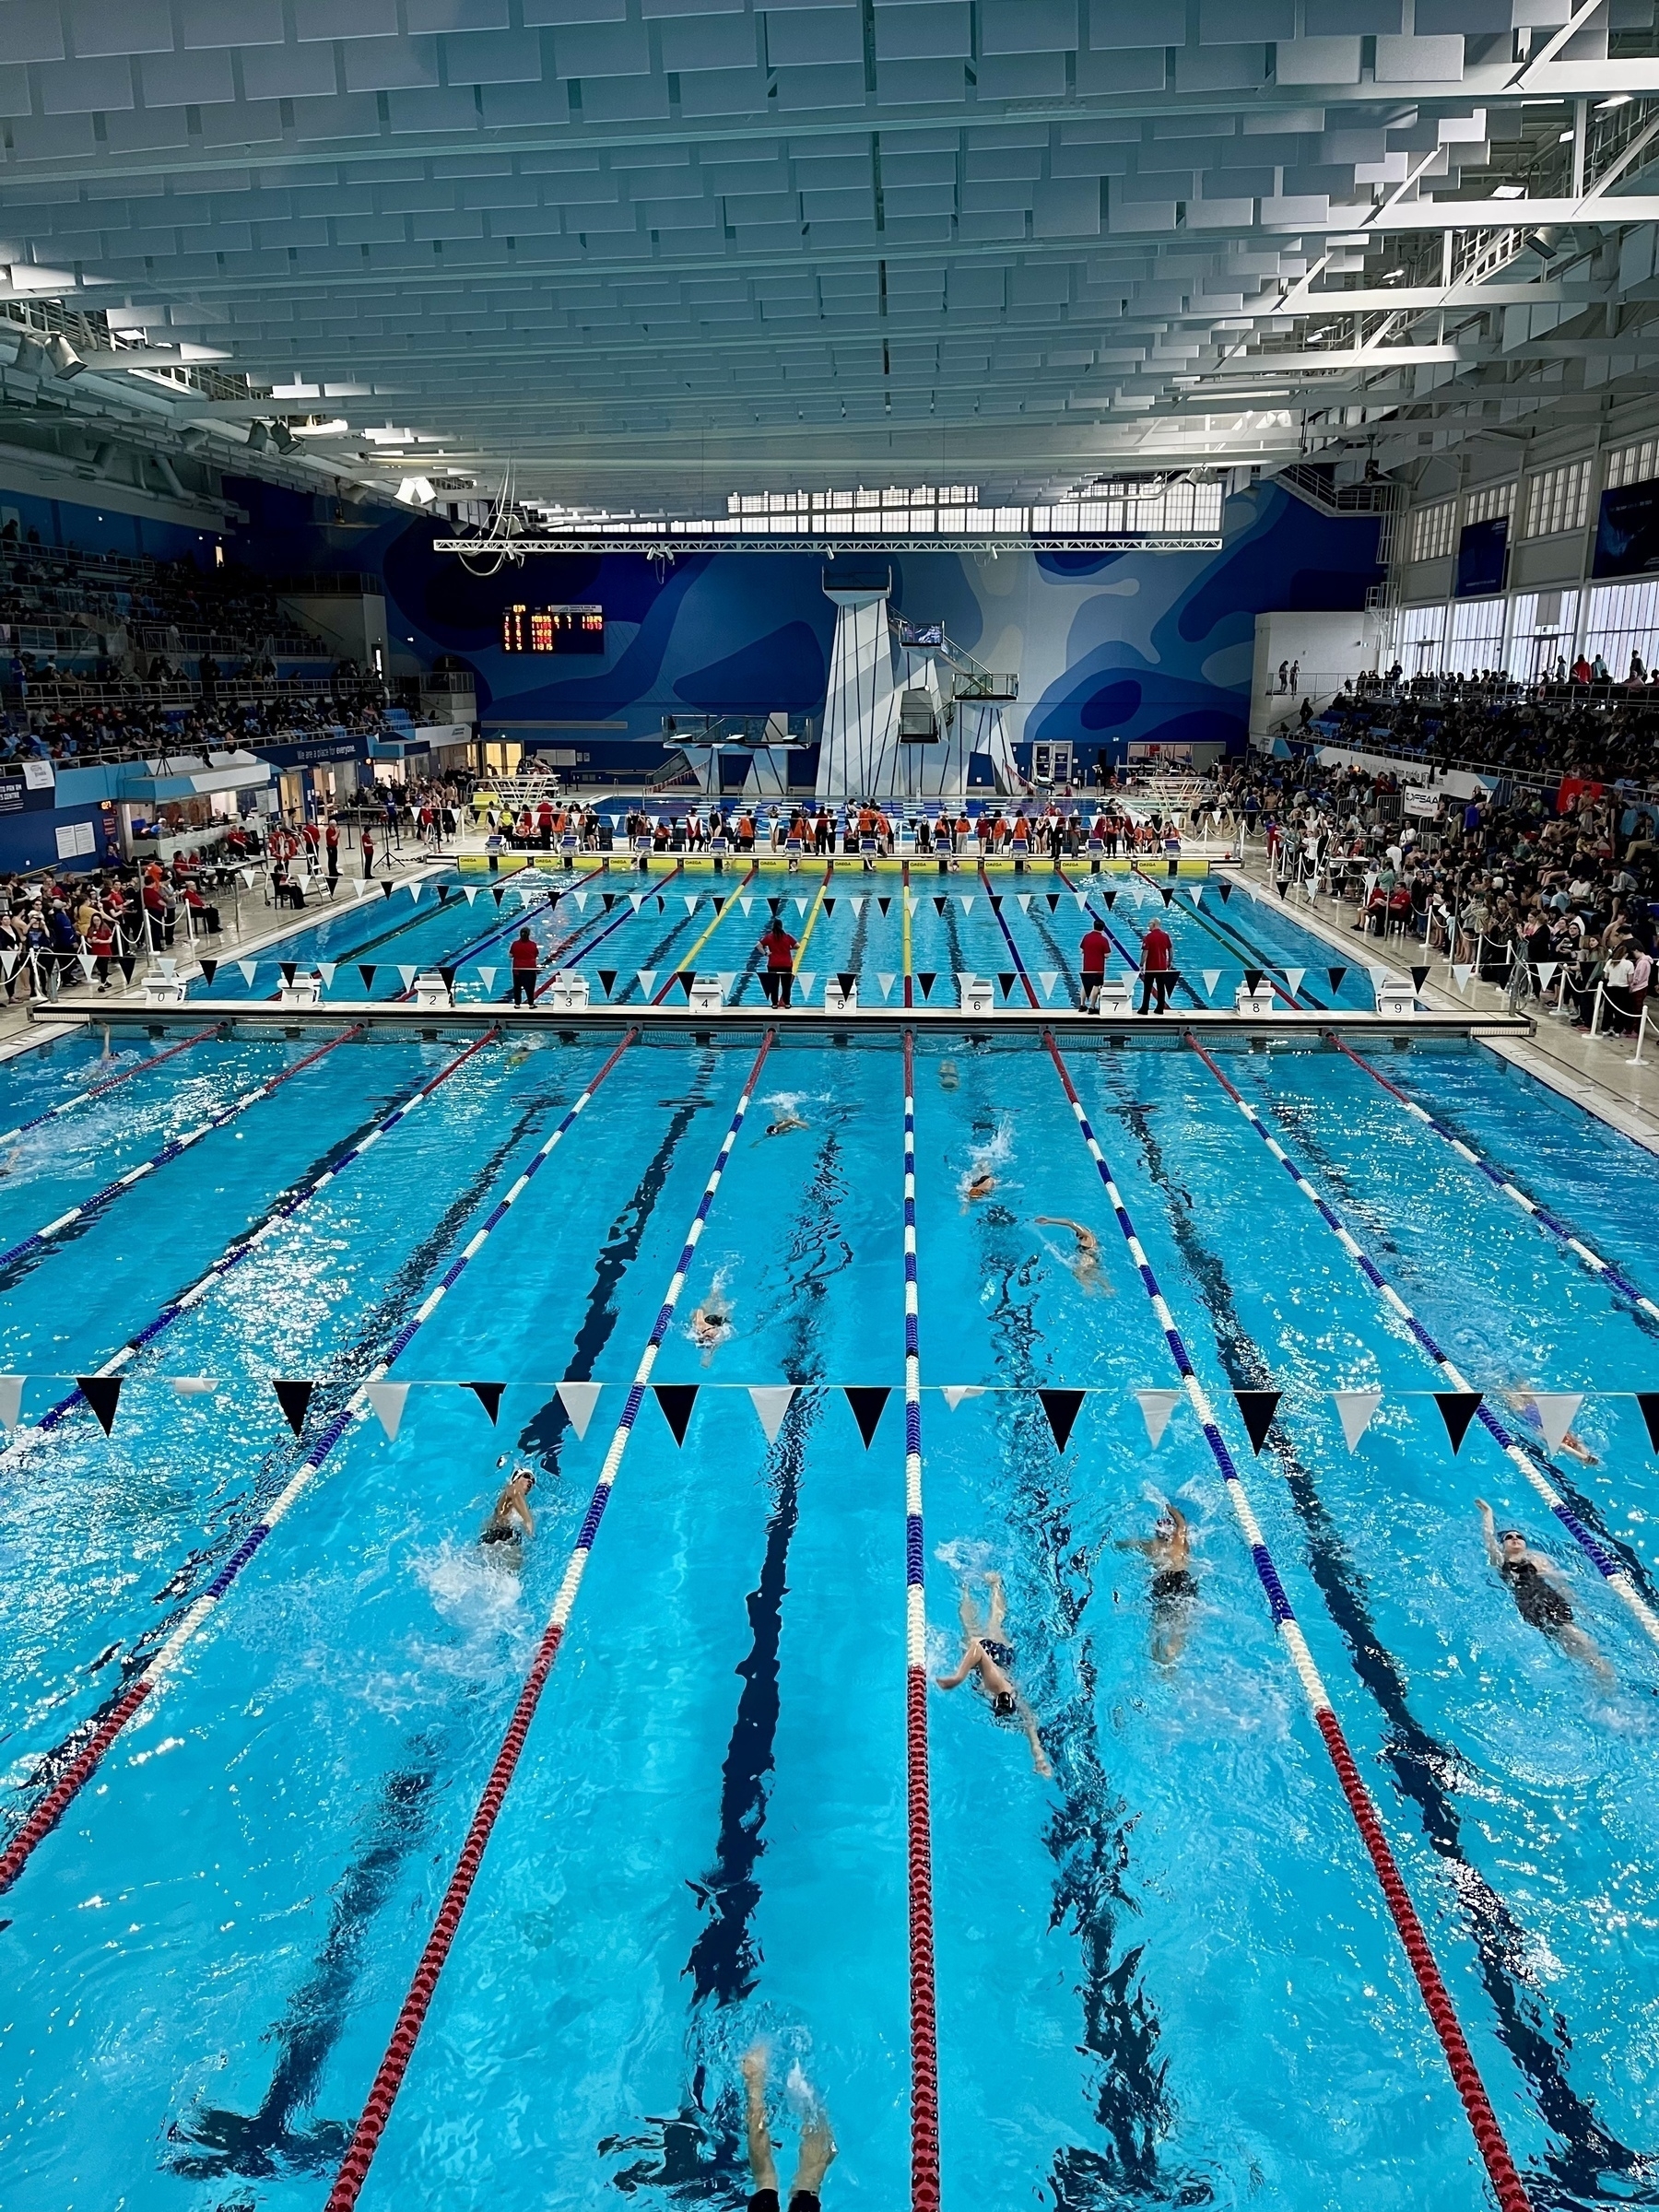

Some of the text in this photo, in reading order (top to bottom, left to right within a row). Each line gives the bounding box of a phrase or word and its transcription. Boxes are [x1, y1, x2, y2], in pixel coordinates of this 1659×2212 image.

[158, 992, 165, 1002] 0
[295, 994, 300, 1003] 1
[429, 995, 436, 1005] 2
[565, 997, 572, 1007] 3
[701, 999, 709, 1008] 4
[837, 1000, 844, 1009] 5
[974, 1001, 981, 1011] 6
[1112, 1002, 1119, 1012] 7
[1253, 1003, 1260, 1012] 8
[1394, 1003, 1402, 1013] 9
